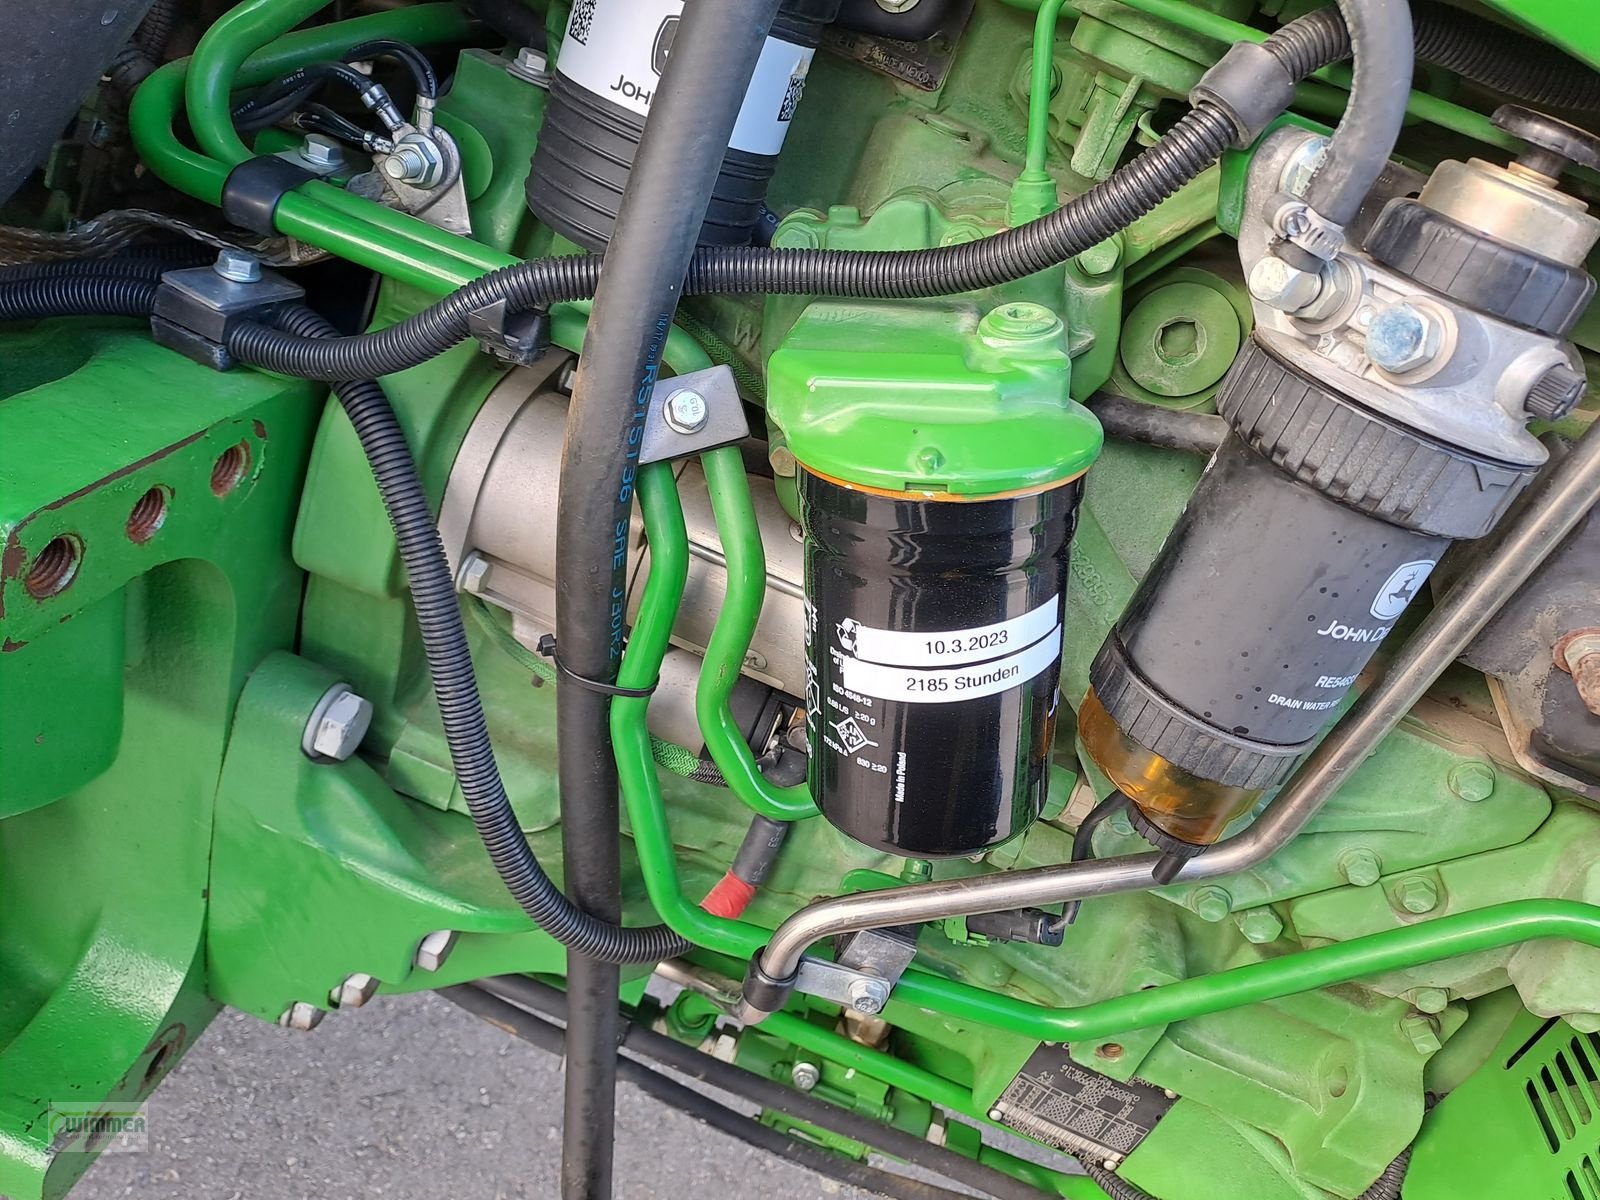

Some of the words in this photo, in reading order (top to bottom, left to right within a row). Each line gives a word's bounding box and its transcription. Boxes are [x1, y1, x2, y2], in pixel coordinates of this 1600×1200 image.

[613, 518, 628, 571] SAE
[925, 630, 1008, 655] 10.3.2023
[1317, 620, 1370, 642] JOHN
[906, 677, 948, 692] 2185
[954, 664, 1020, 691] Stunden
[1267, 693, 1302, 709] DRAIN
[1302, 701, 1331, 711] WATER
[894, 782, 905, 802] Made
